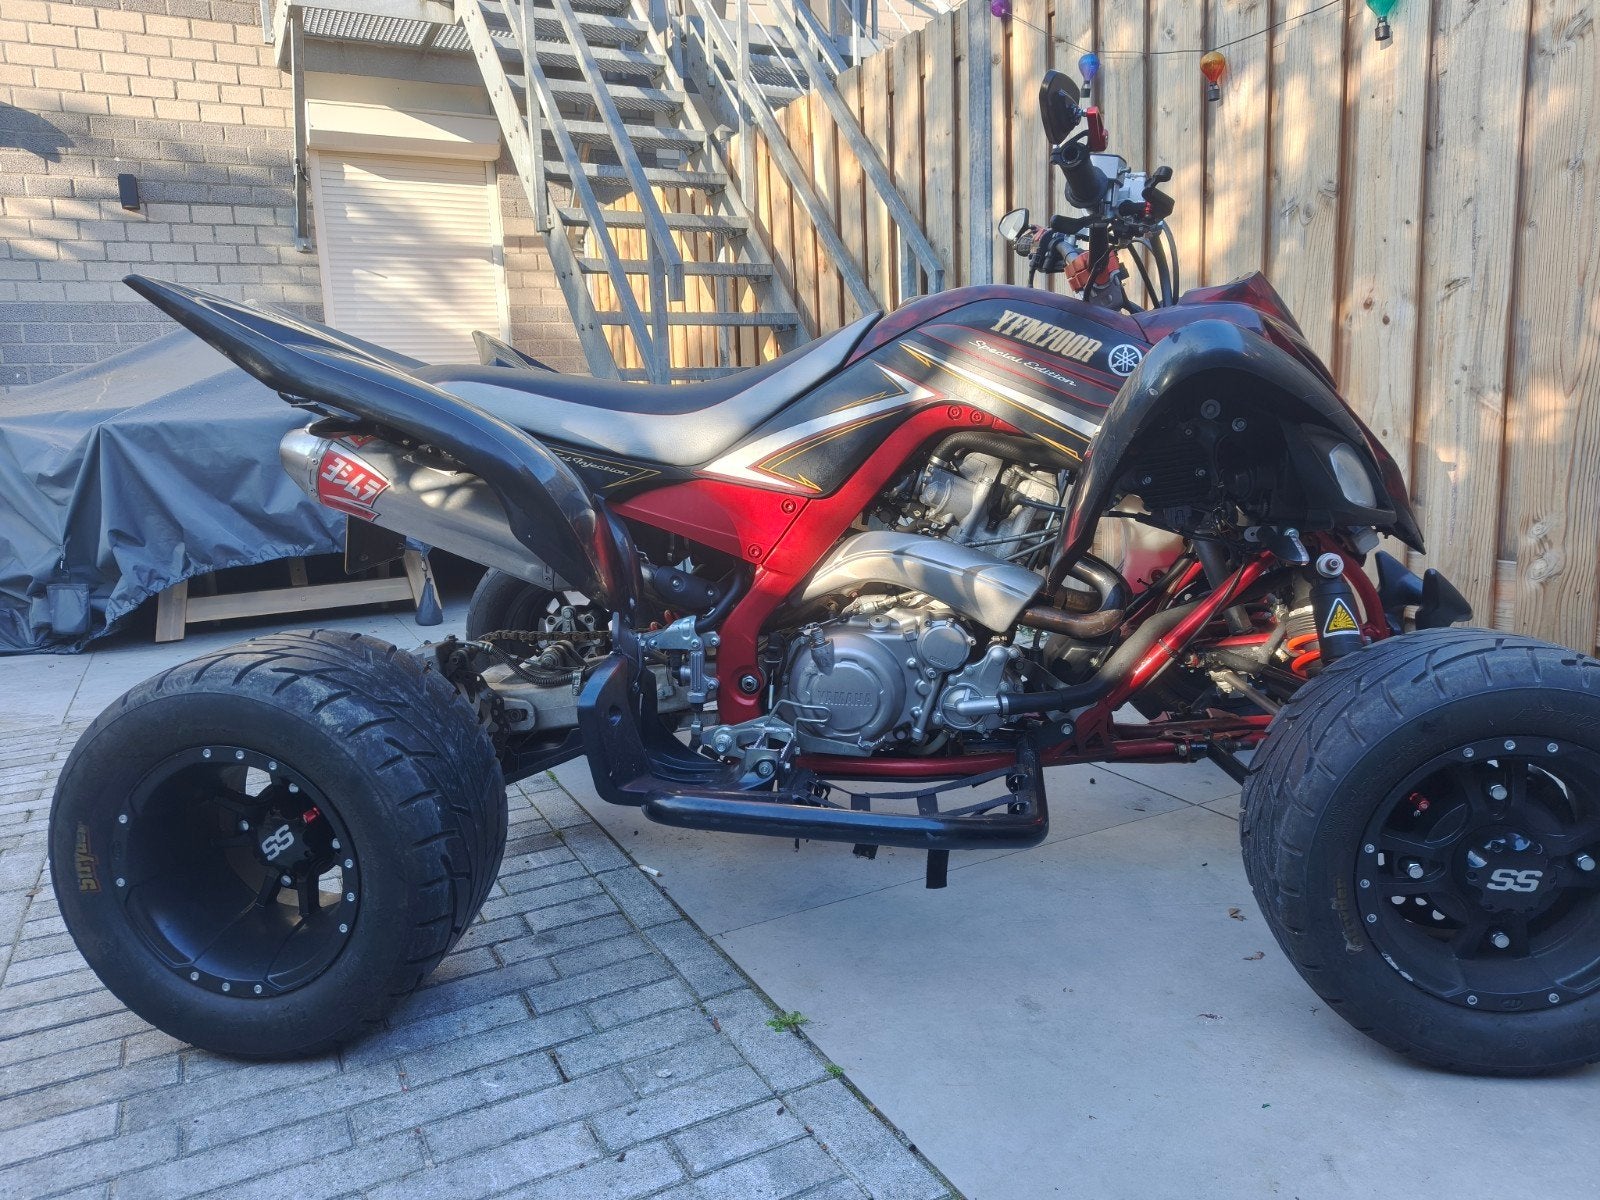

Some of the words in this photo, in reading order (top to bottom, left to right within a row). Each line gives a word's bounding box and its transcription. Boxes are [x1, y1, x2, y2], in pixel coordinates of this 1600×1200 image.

[990, 309, 1103, 363] YFM700R
[969, 340, 1023, 364] Special
[1024, 361, 1077, 387] Edition
[261, 824, 295, 861] SS
[1486, 868, 1543, 892] SS
